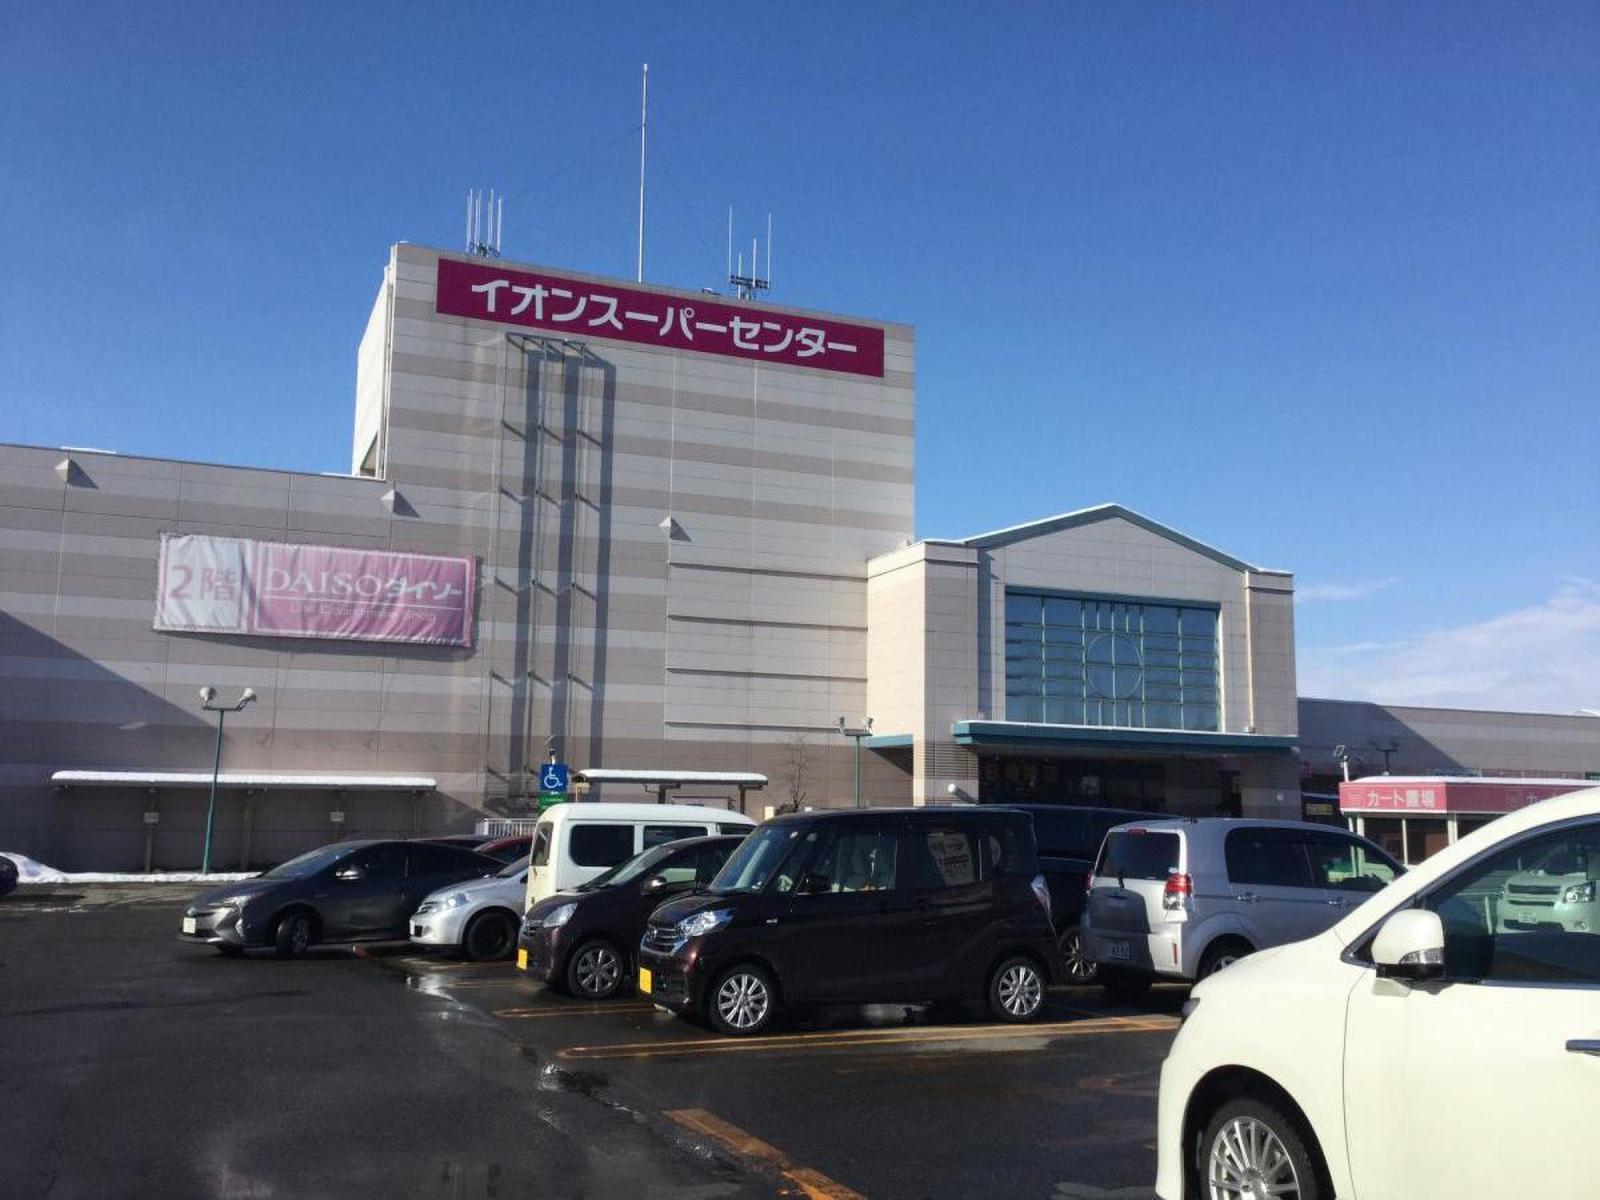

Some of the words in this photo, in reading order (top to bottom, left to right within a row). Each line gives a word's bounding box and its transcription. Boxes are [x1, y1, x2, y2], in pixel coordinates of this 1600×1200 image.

[471, 279, 857, 358] イオンスーパーセンター
[170, 564, 237, 601] 2階
[264, 567, 382, 597] DAISO
